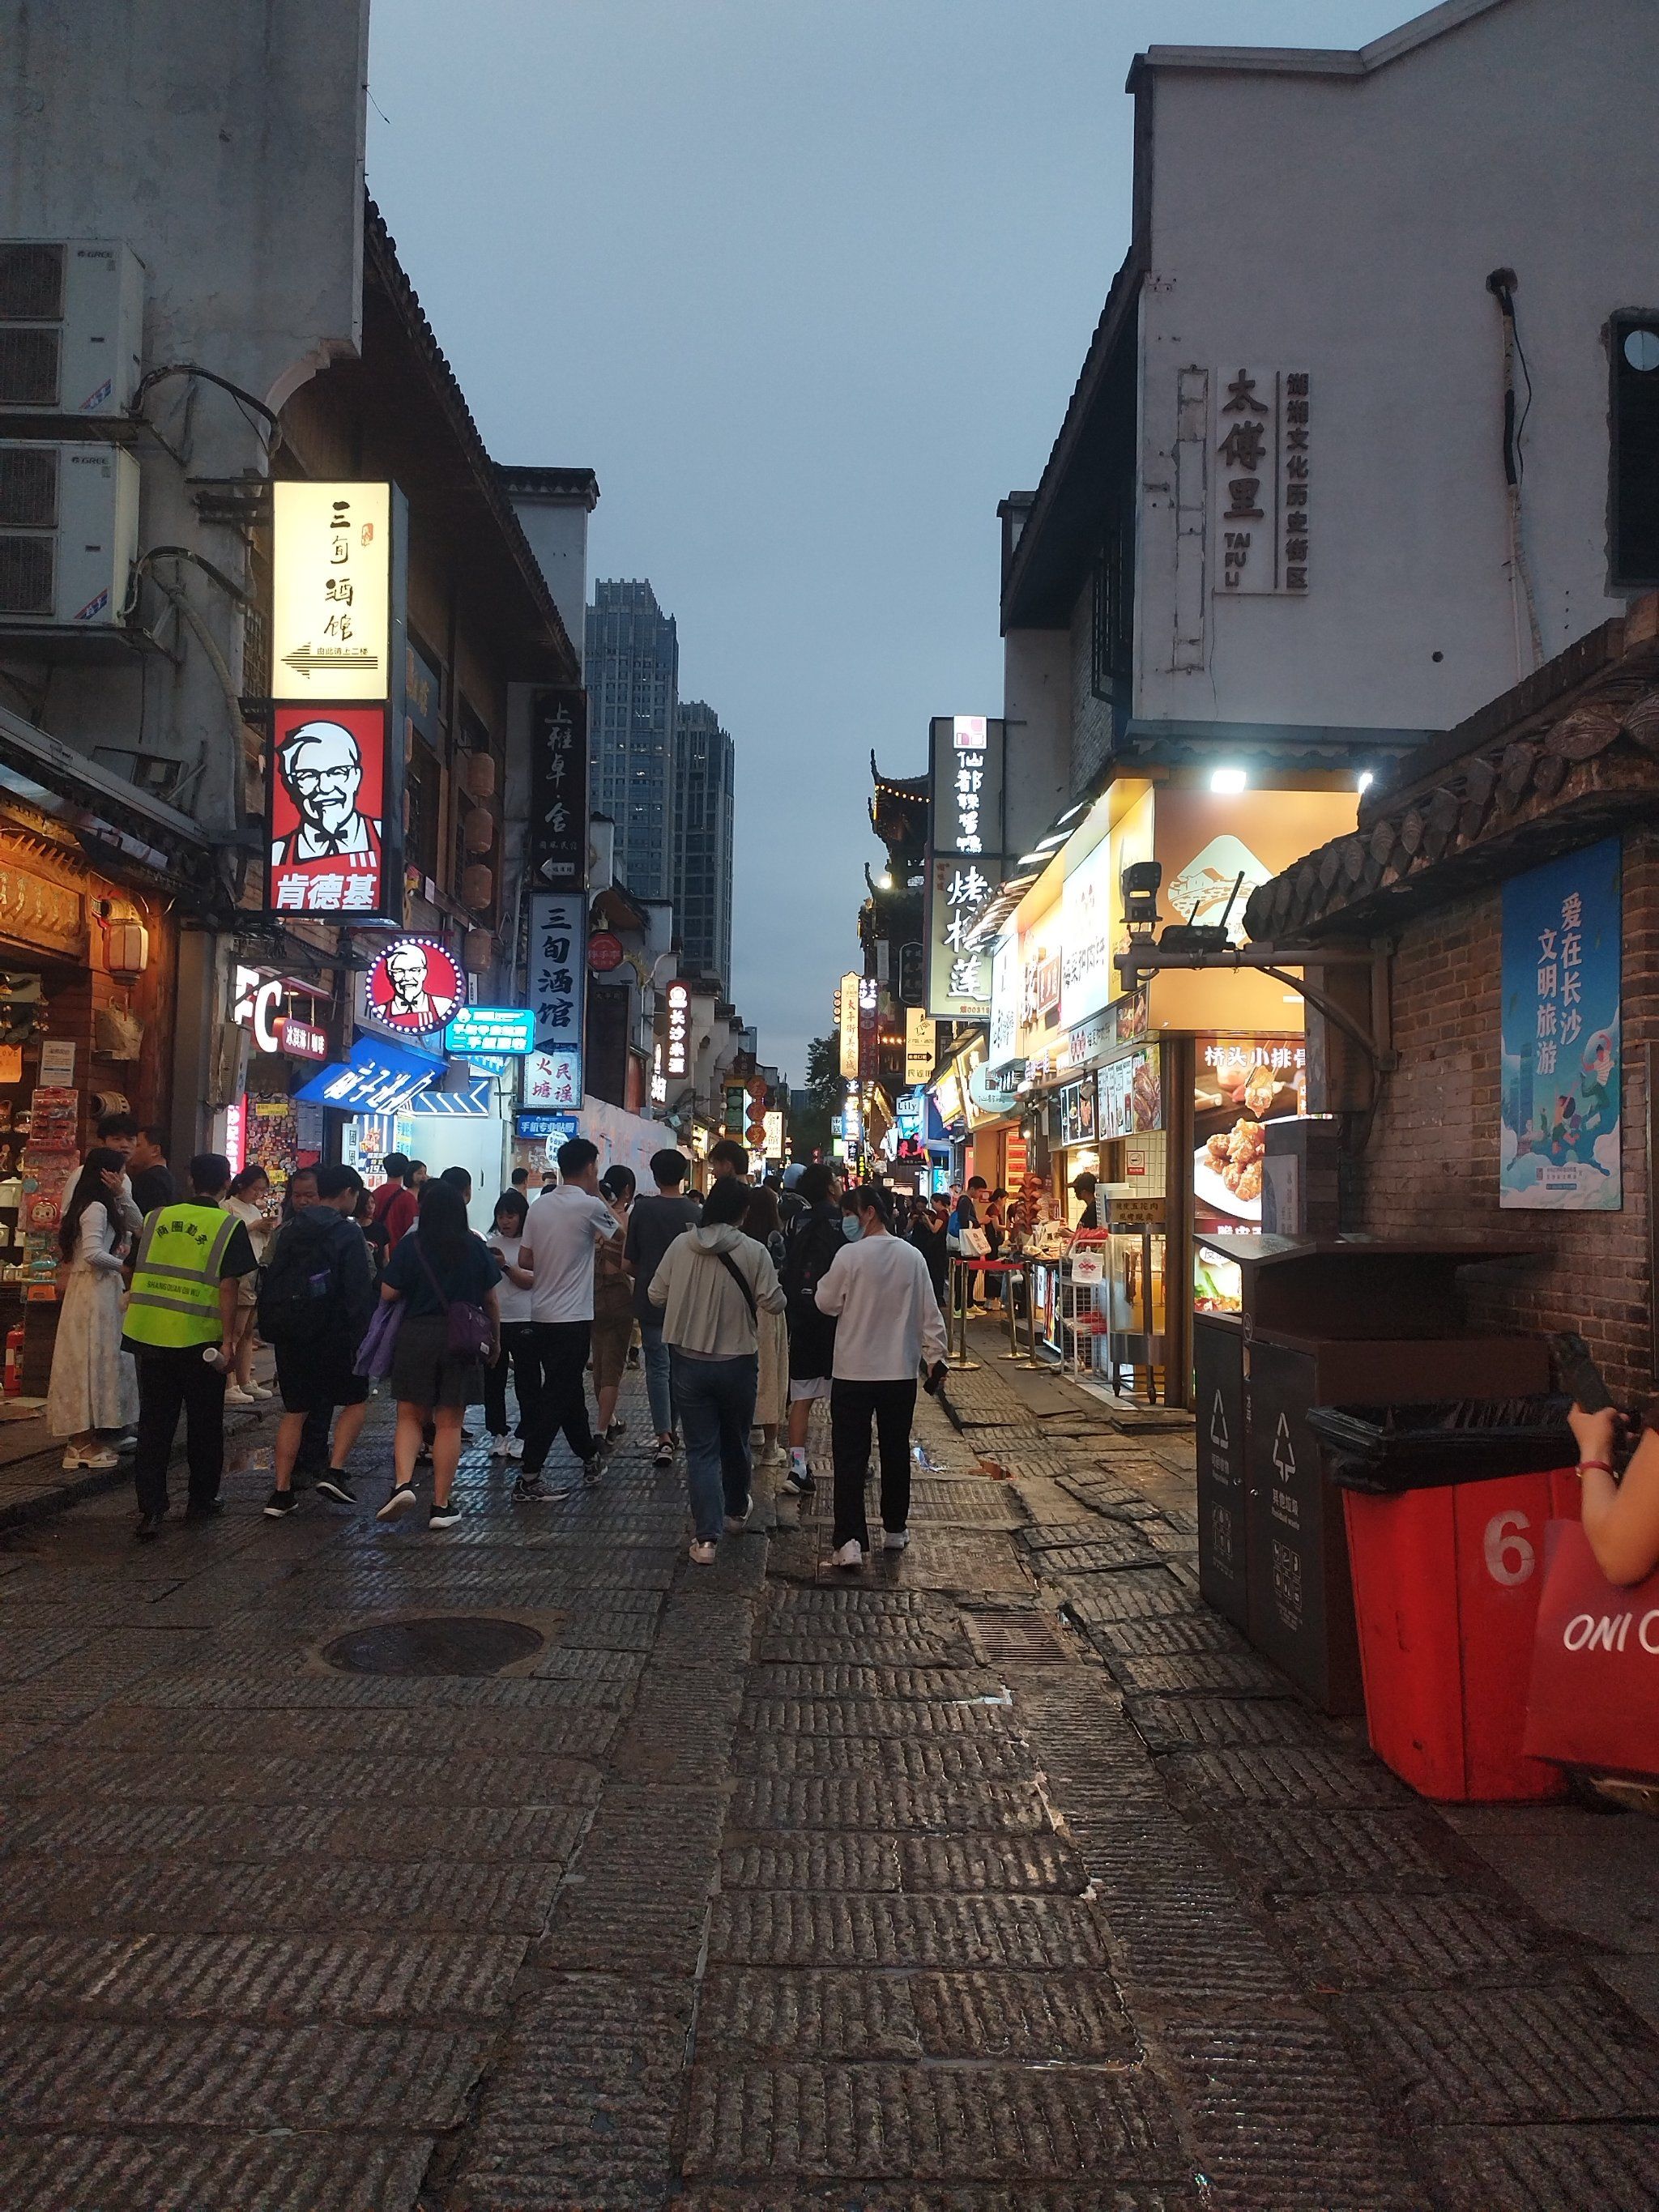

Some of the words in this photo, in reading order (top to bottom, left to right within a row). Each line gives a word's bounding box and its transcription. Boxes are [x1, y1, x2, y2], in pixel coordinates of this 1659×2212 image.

[81, 457, 109, 465] GREE
[1224, 532, 1251, 548] TAI
[324, 501, 353, 641] 三旬酒馆
[1225, 552, 1247, 568] FU
[276, 872, 376, 910] 肯德基
[537, 909, 574, 1028] 三旬酒馆
[1560, 891, 1584, 1045] 爱在长沙
[1537, 928, 1558, 1076] 文明旅游
[155, 1221, 208, 1246] 商圈勤务
[1273, 1487, 1299, 1517] 其他垃圾
[1483, 1510, 1536, 1586] 6
